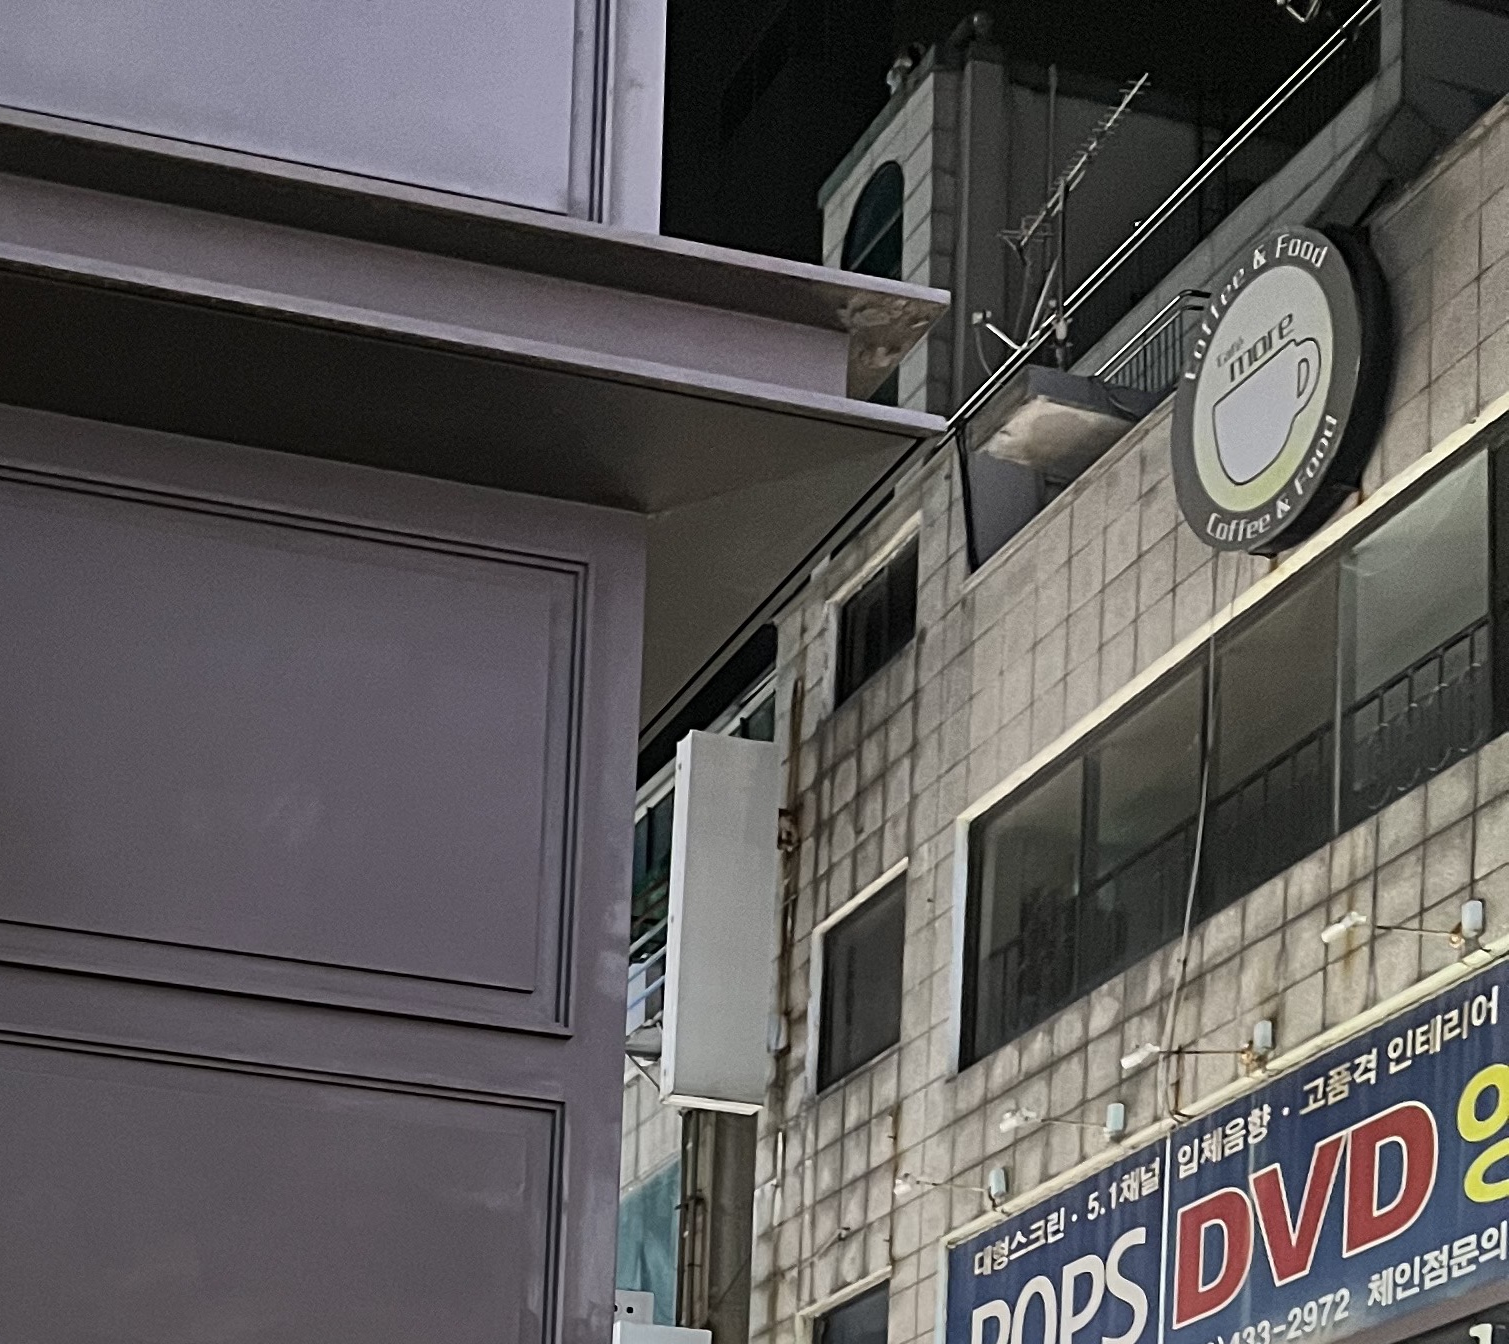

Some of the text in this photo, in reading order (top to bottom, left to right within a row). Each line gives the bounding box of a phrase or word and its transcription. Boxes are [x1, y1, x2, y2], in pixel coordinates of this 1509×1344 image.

[1275, 234, 1328, 269] Food
[1229, 313, 1296, 384] more
[1206, 511, 1271, 542] Coffee
[1294, 414, 1338, 496] Food
[974, 1208, 1065, 1277] 대형스크린
[1299, 1052, 1378, 1116] 고품격
[1387, 986, 1499, 1075] 인테리어
[1172, 1100, 1439, 1331] DVD
[1367, 1224, 1509, 1309] 체인점문의
